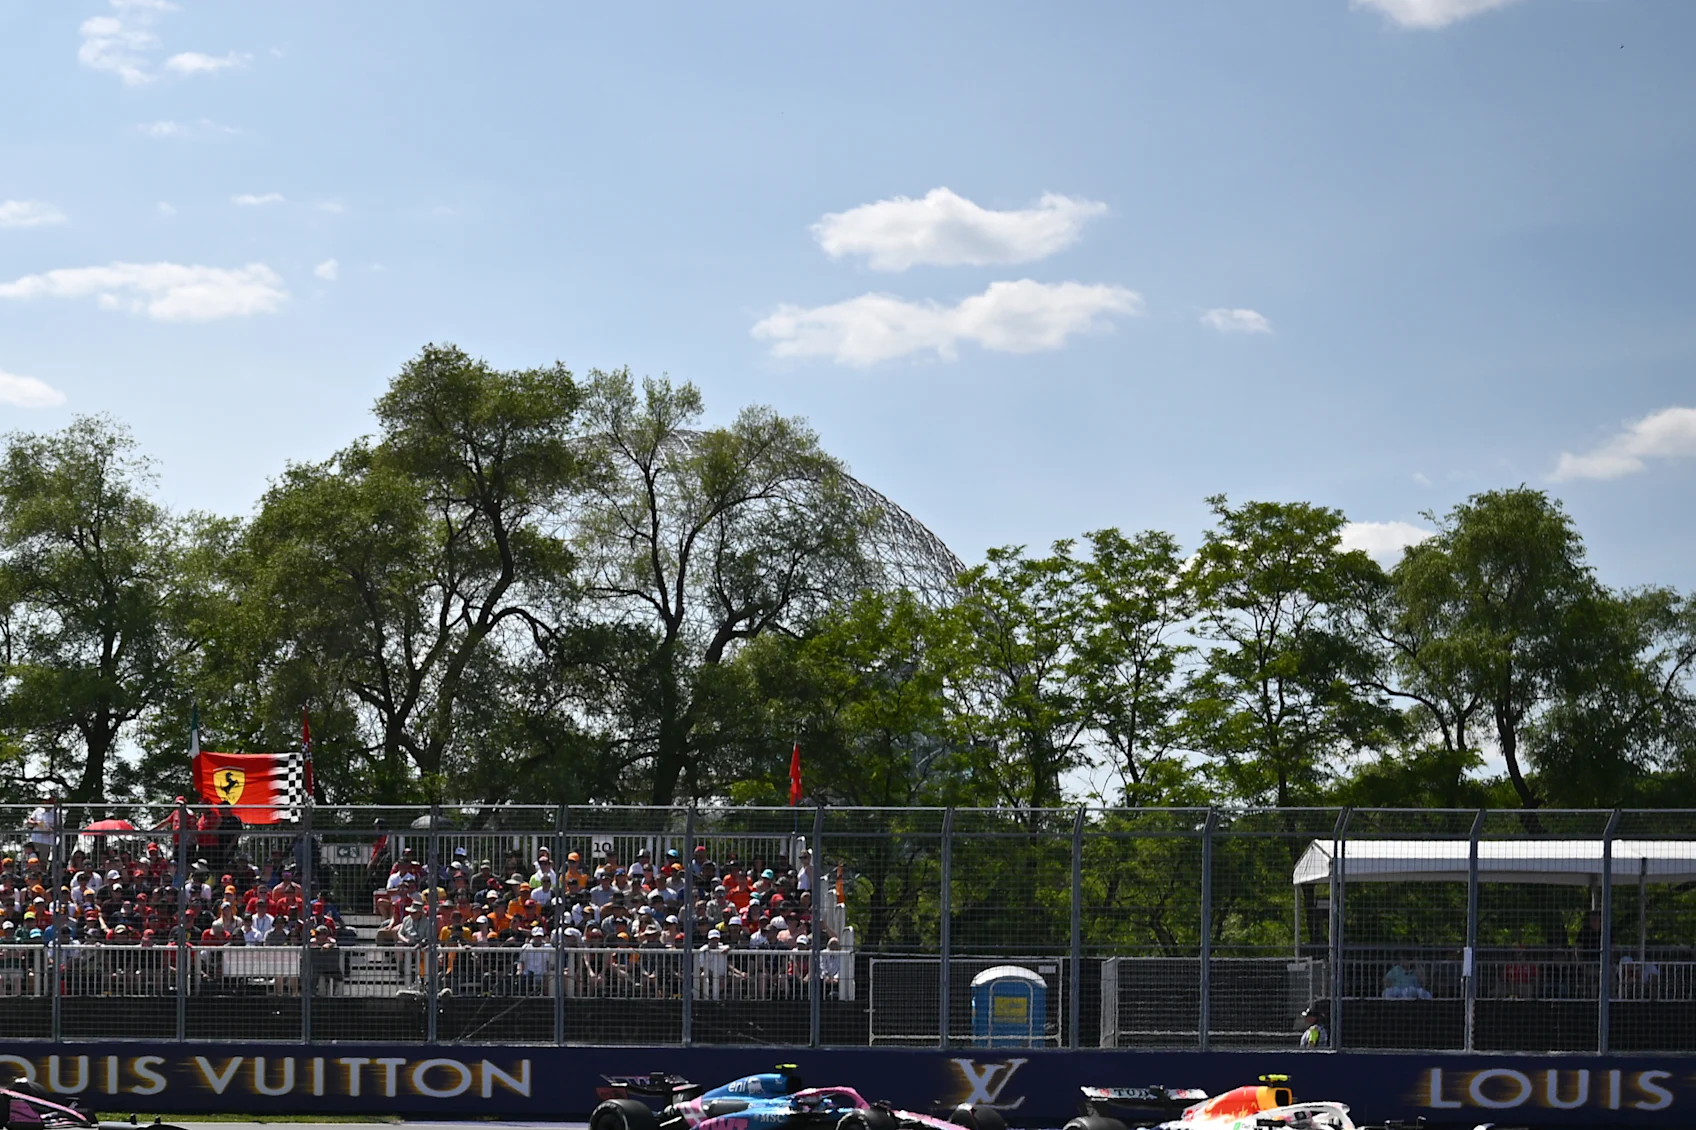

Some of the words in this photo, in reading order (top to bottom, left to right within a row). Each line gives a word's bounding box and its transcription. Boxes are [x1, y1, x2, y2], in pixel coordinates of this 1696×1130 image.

[594, 842, 612, 853] 10
[195, 1056, 532, 1098] VUITTON
[728, 1081, 747, 1094] eni
[1431, 1068, 1674, 1111] LOUIS
[760, 1114, 786, 1123] MSC
